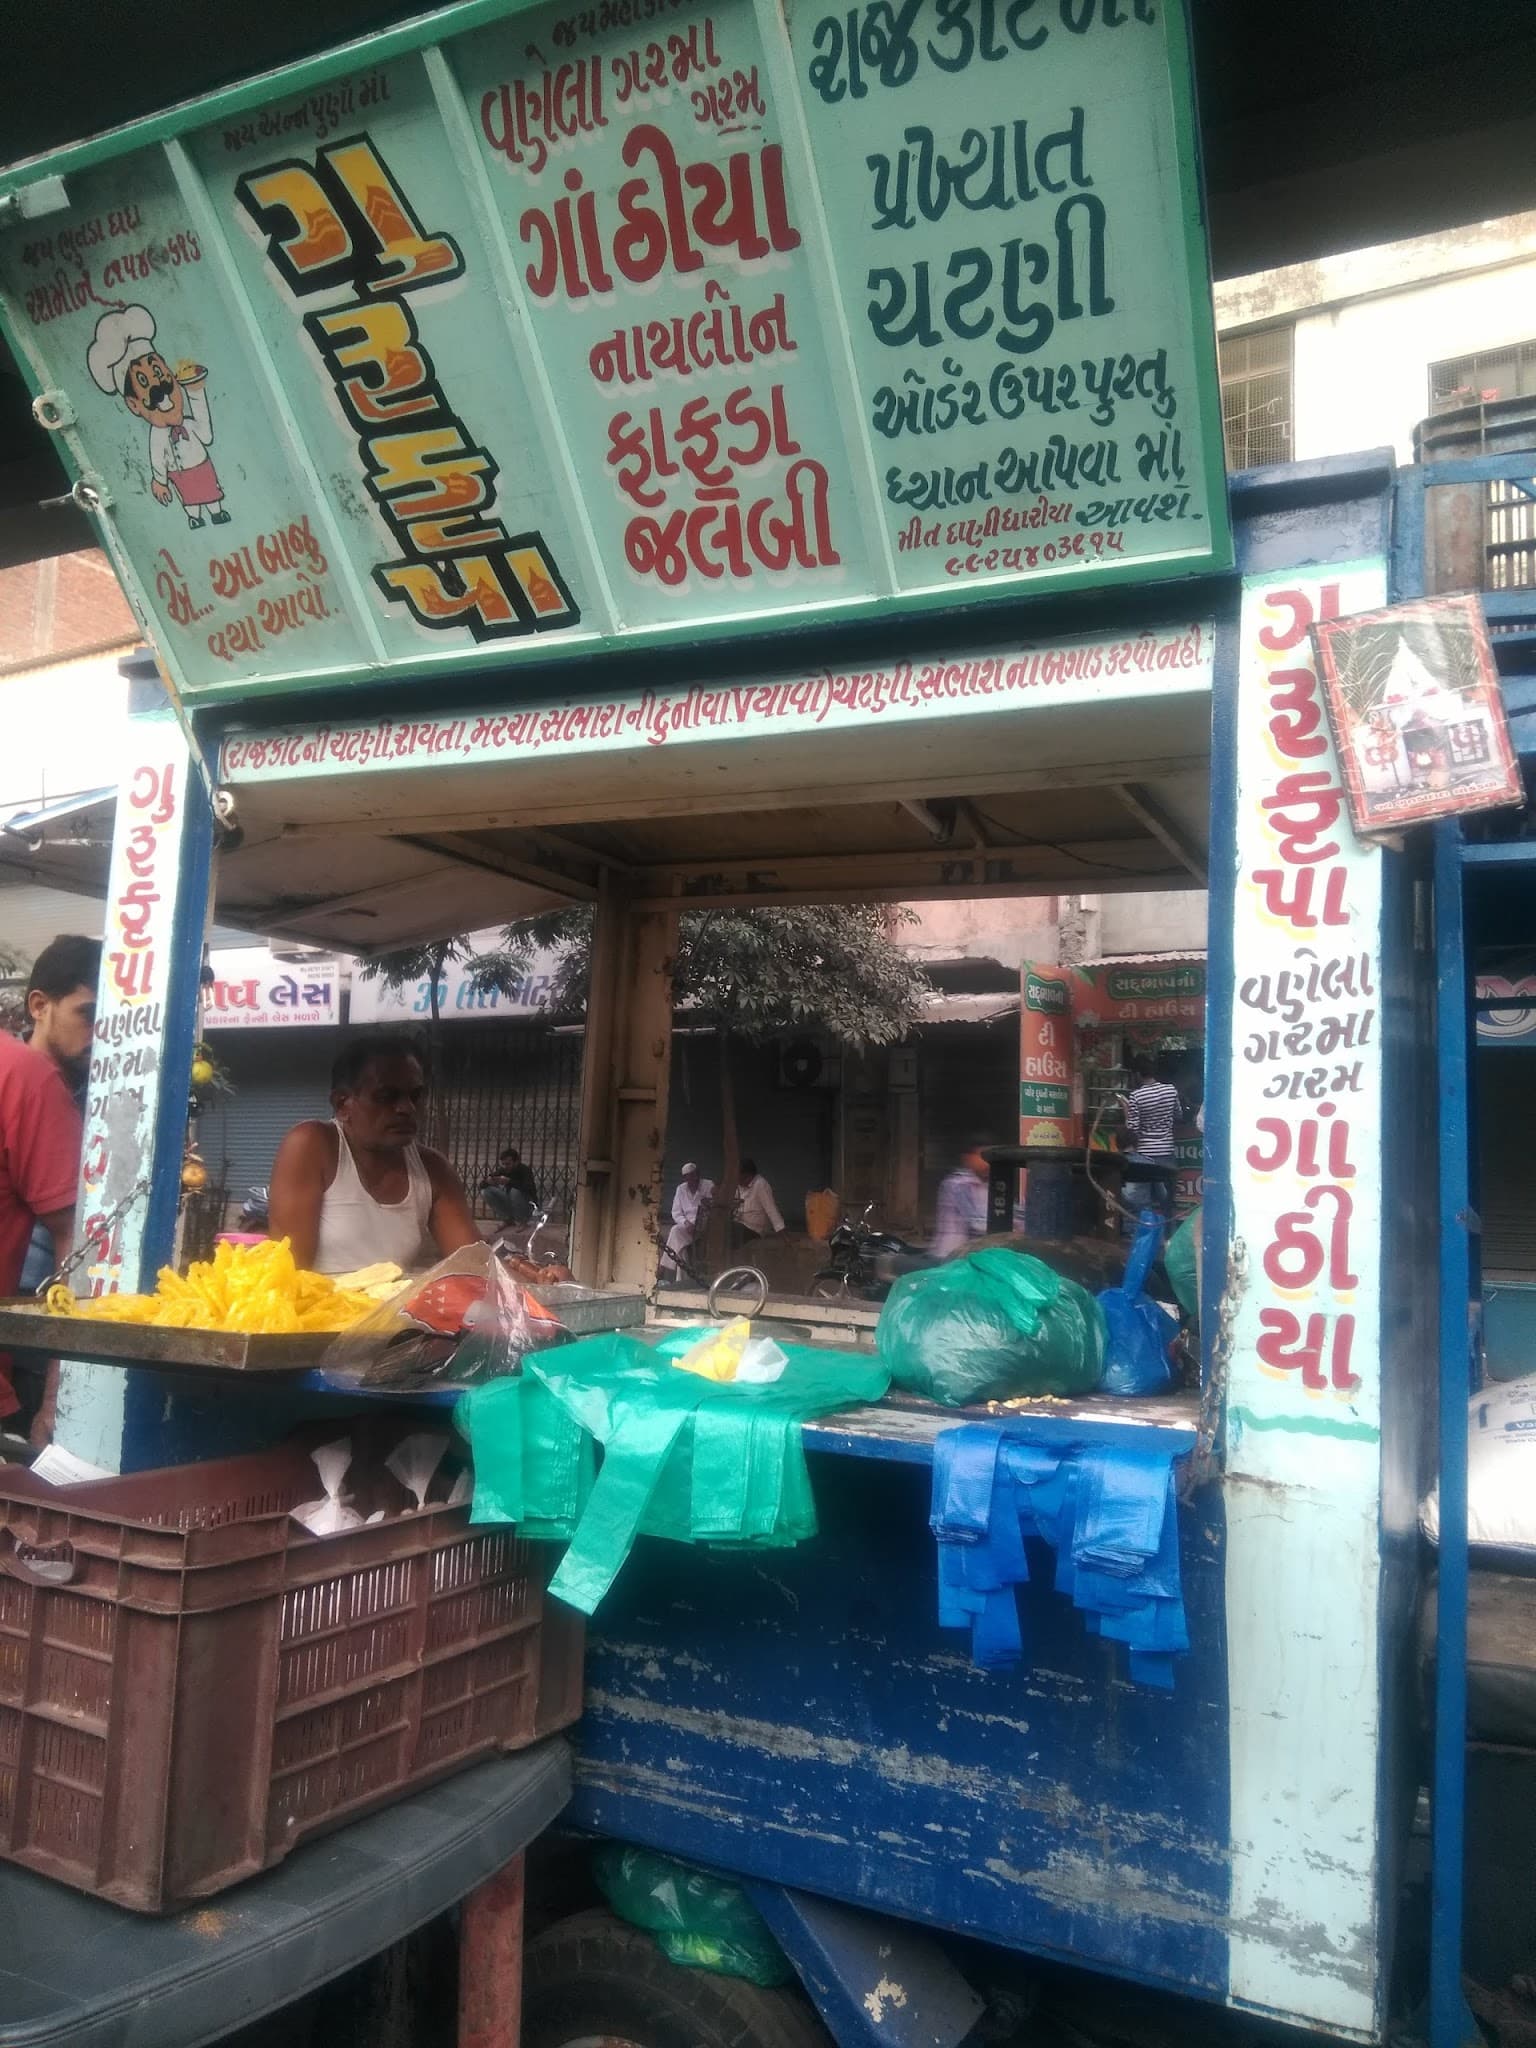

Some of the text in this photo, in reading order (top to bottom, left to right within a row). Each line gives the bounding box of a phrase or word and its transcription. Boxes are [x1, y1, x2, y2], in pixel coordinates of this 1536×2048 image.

[481, 17, 721, 174] વણેલા ગરમા
[691, 65, 766, 126] ગરમ
[866, 107, 1094, 231] પ્રખ્યાત
[520, 124, 801, 298] ગાંઠીયા
[866, 193, 1116, 354] ચટણી
[607, 385, 801, 508] ફાફડા
[257, 515, 328, 575] બાજુ
[268, 976, 332, 1007] લેસ
[1240, 948, 1374, 1022] વણેલા
[1244, 1009, 1374, 1063] ગરમા
[1263, 1061, 1364, 1099] ગરમ
